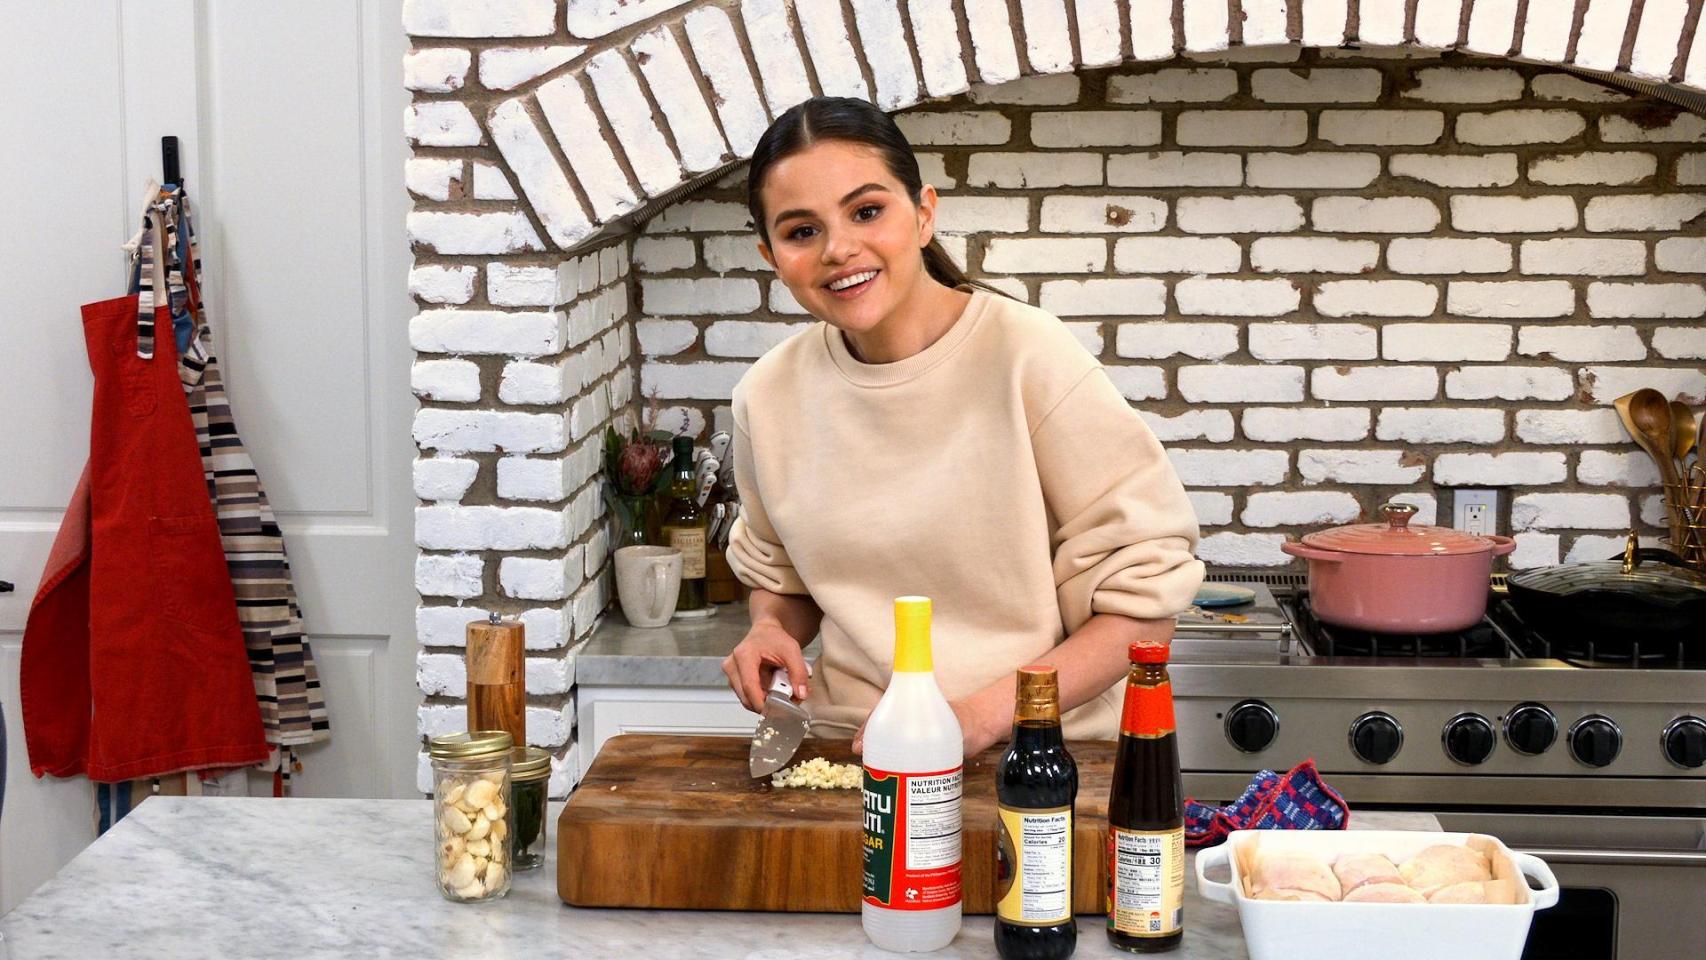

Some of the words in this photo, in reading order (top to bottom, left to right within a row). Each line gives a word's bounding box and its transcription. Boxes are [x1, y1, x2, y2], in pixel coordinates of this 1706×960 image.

[911, 778, 951, 787] NUTRITION
[911, 786, 941, 794] VALEUR
[1134, 836, 1147, 844] Facts
[1149, 857, 1161, 865] 30
